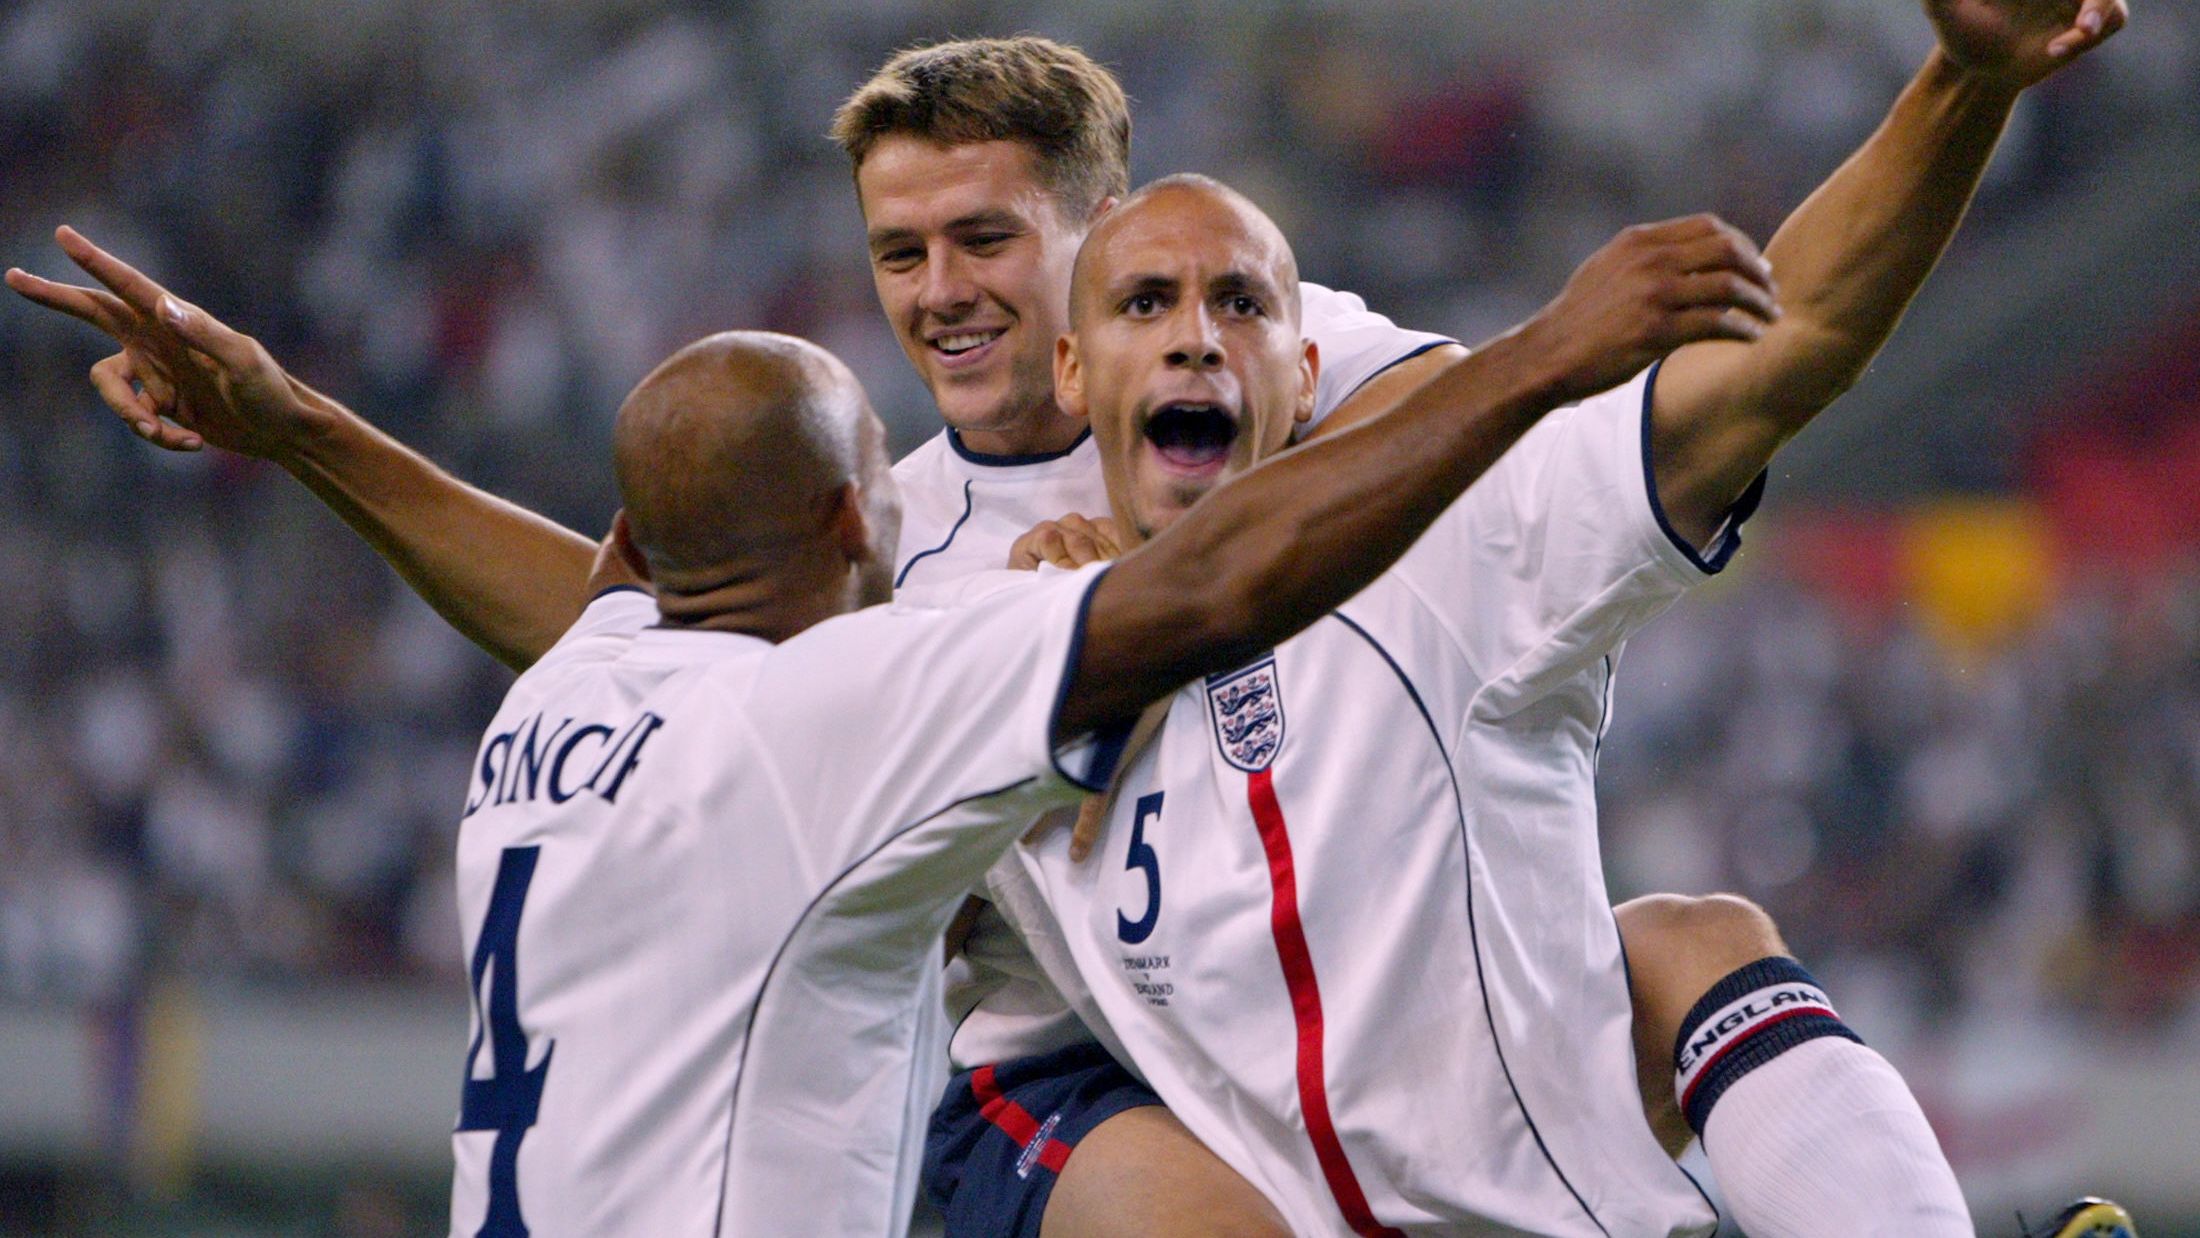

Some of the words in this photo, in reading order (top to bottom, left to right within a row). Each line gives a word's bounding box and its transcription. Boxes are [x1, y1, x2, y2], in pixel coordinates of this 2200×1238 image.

[1117, 791, 1165, 944] 5
[453, 845, 556, 1238] 4
[1679, 990, 1828, 1077] ENGLAN
